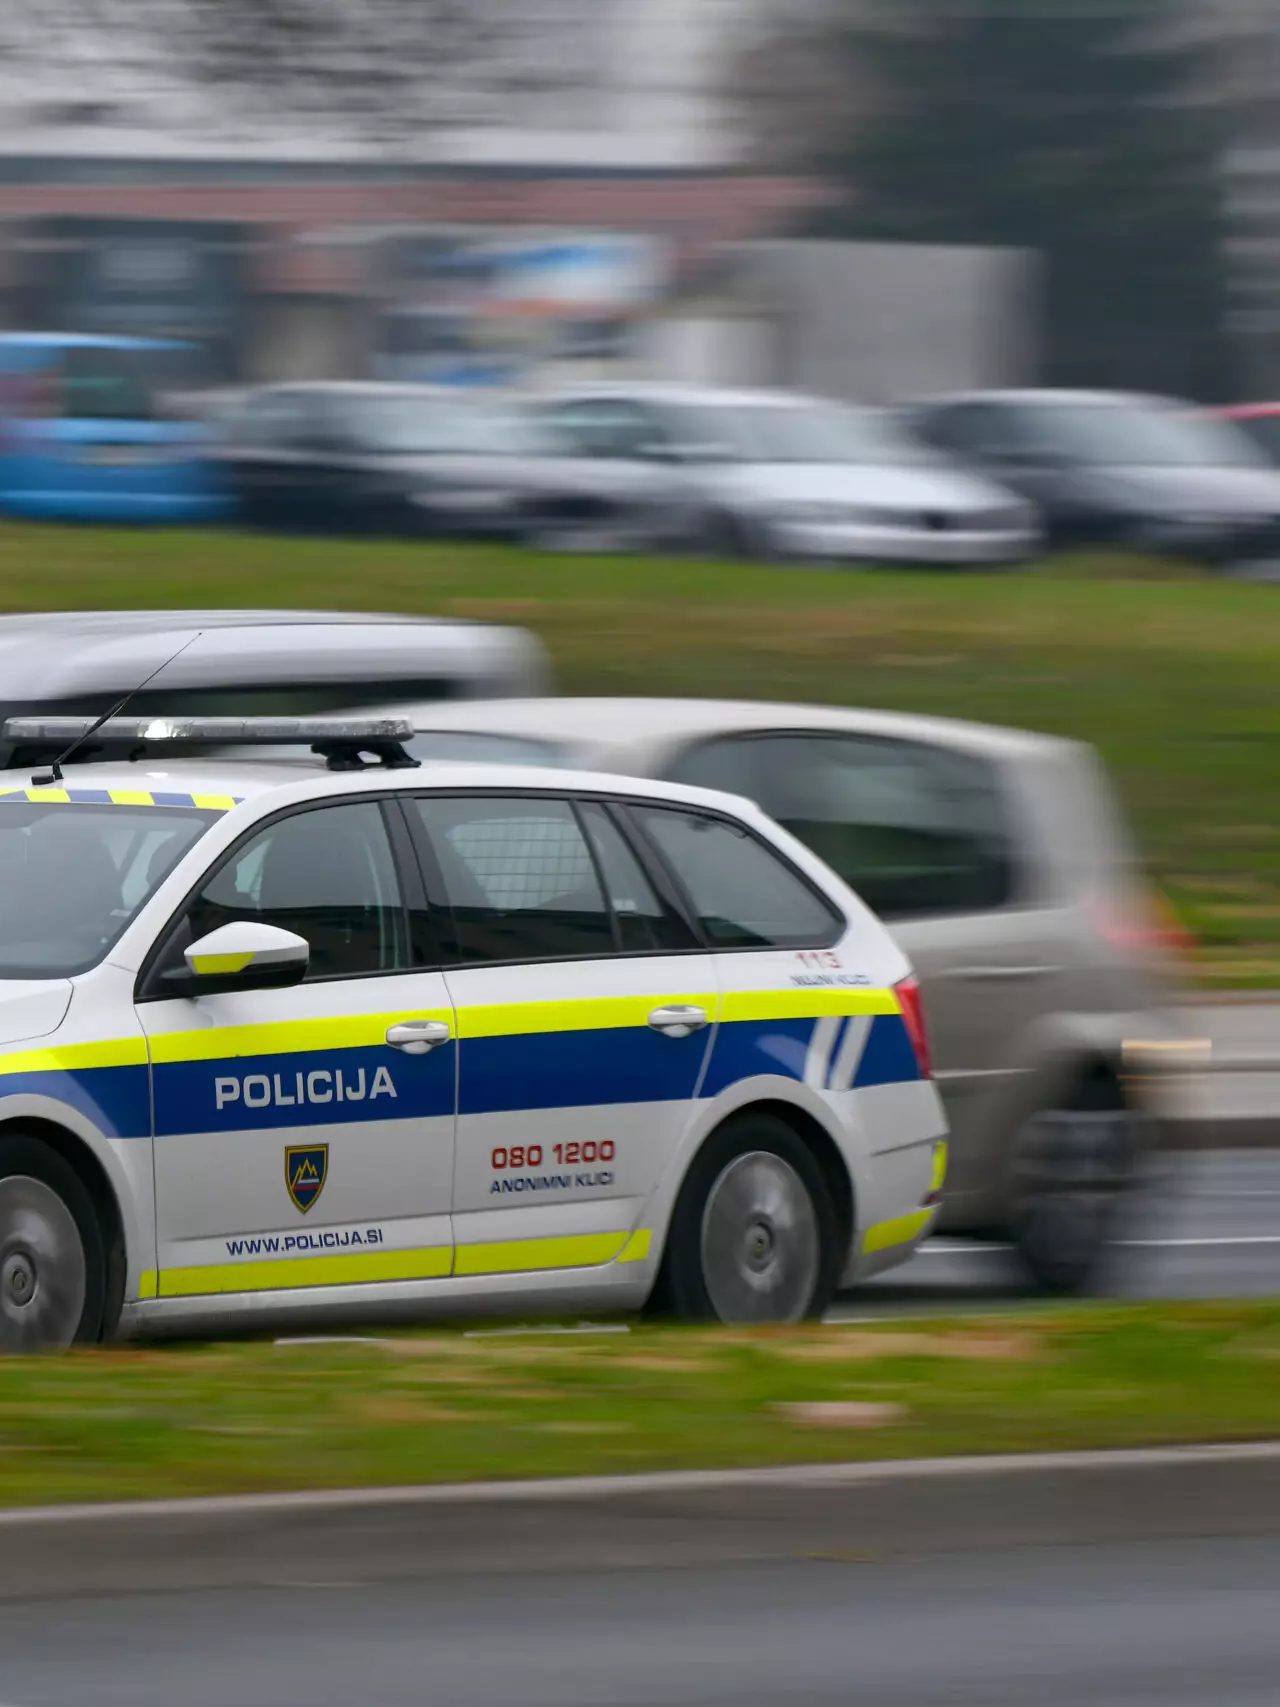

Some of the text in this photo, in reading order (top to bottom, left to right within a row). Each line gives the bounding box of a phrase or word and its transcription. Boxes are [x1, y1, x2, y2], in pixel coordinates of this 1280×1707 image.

[797, 951, 842, 969] 113
[214, 1066, 398, 1110] POLICIJA
[491, 1140, 615, 1169] 080 1200
[490, 1175, 572, 1195] ANONIMNI
[226, 1228, 384, 1256] WWW.POLICIJA.SI
